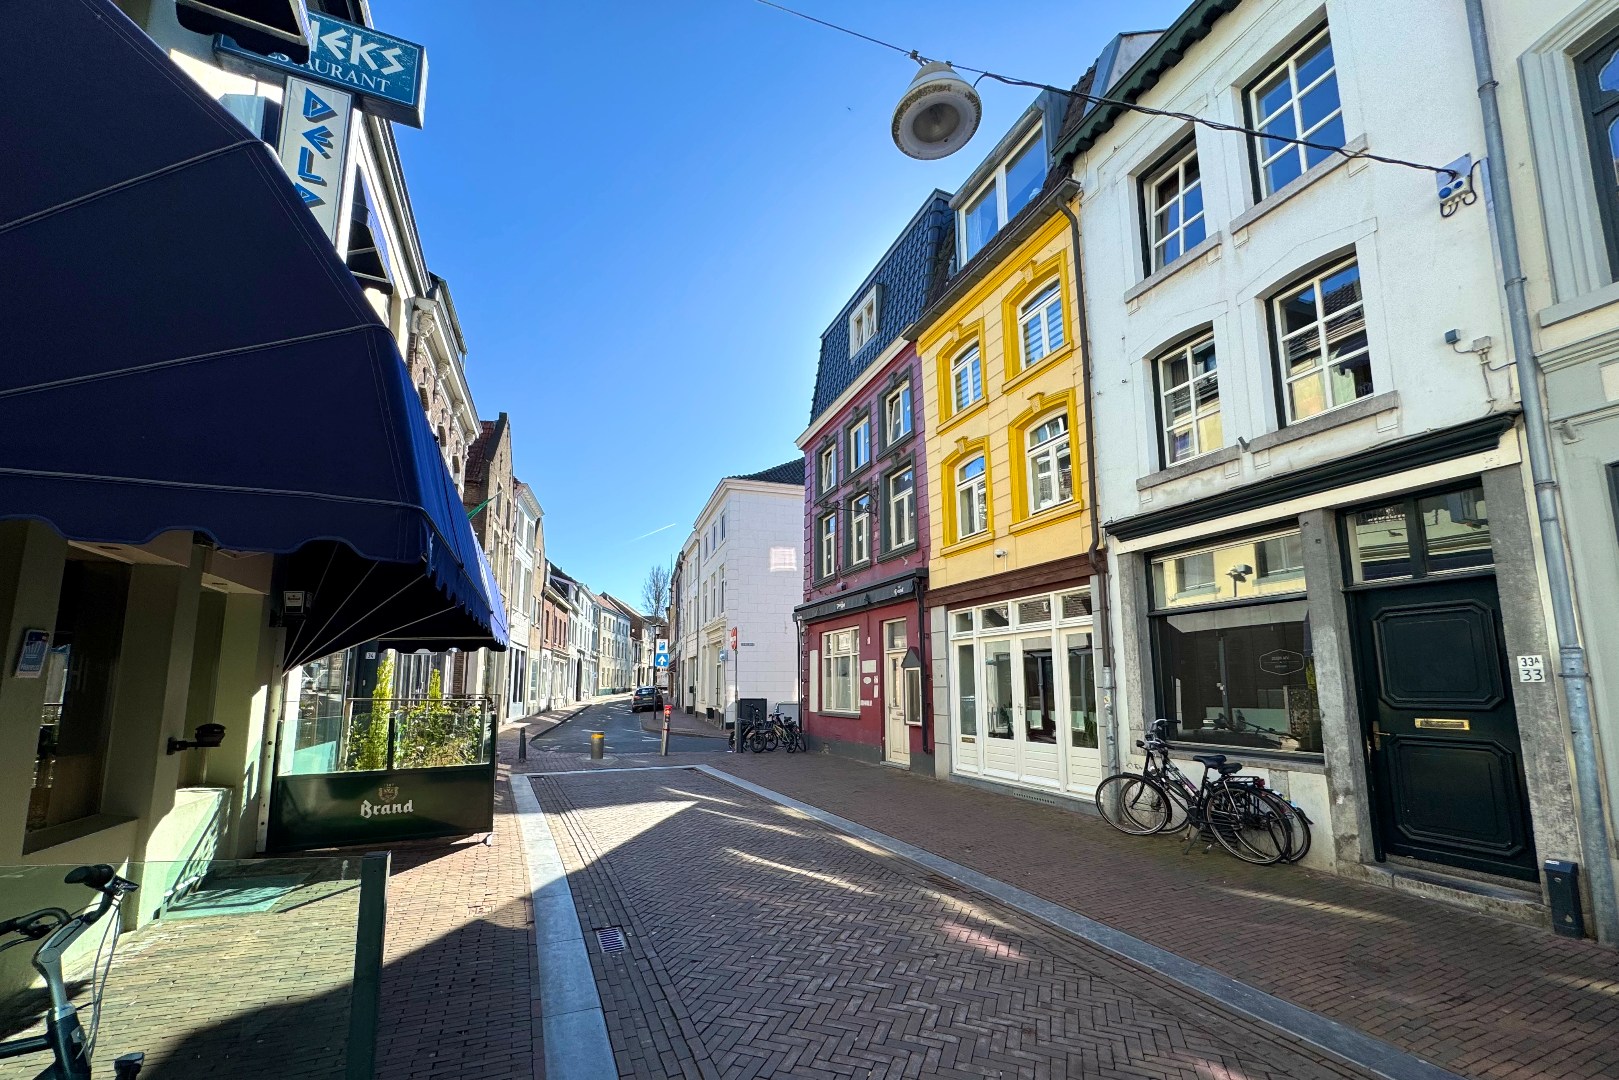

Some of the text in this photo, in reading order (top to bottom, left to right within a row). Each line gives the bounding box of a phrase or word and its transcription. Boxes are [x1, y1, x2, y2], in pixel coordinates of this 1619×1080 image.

[1520, 656, 1540, 667] 33A
[1521, 669, 1543, 682] 33
[360, 799, 414, 819] Brand
